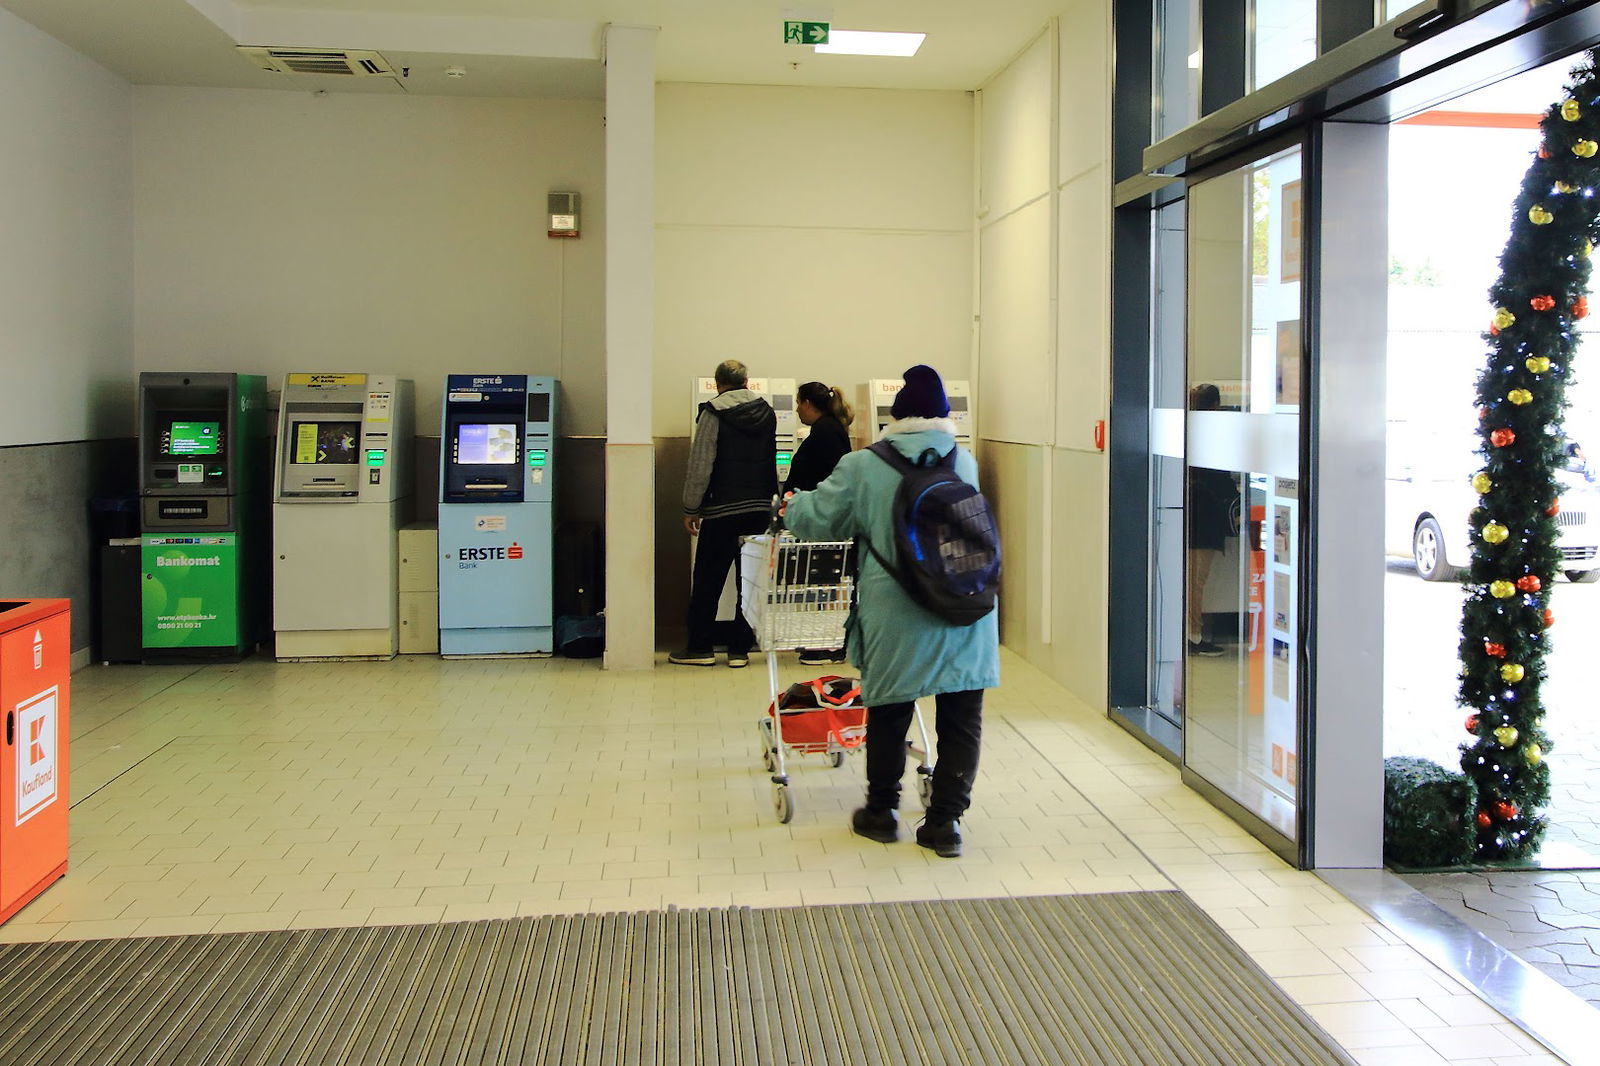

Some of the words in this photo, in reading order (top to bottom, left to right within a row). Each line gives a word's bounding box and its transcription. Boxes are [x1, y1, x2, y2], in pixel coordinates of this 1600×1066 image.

[459, 547, 505, 560] ERSTE
[156, 555, 220, 567] Bankomat
[22, 764, 53, 798] Kaufland
